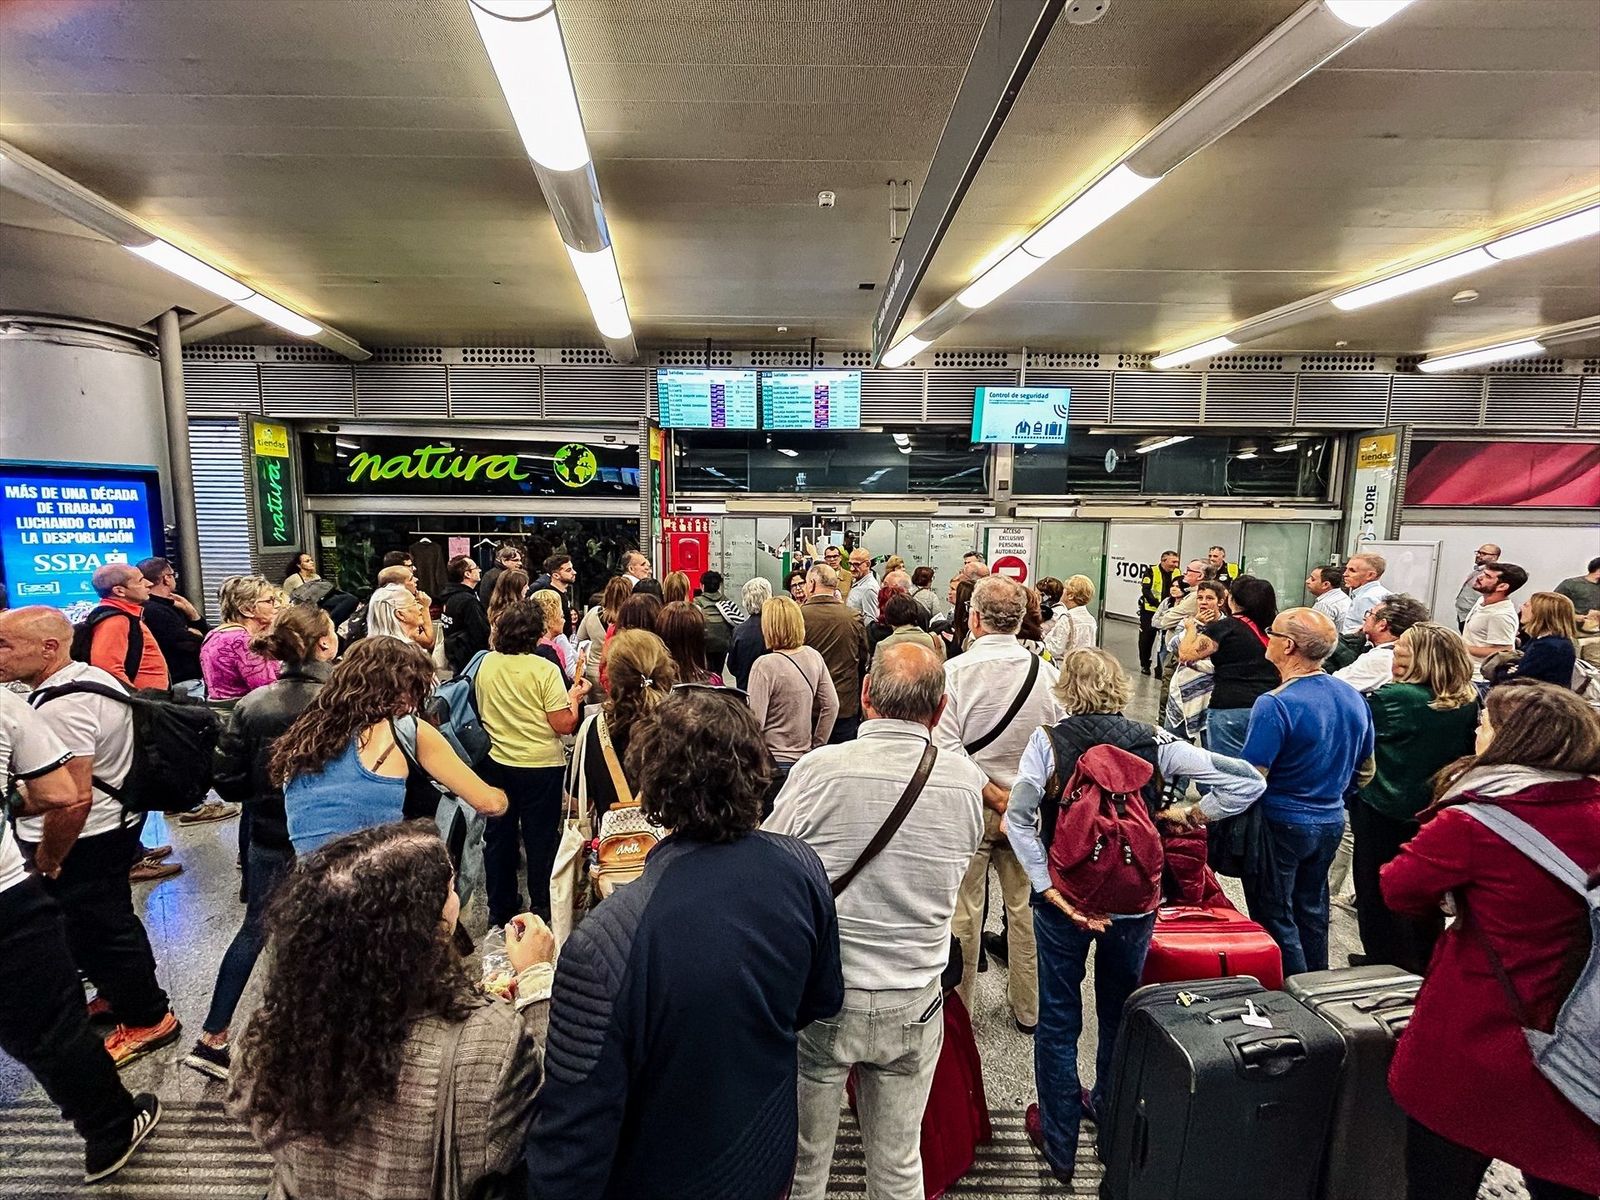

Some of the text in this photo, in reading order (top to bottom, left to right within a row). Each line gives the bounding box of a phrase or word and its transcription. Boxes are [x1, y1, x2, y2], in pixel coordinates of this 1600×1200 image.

[257, 439, 286, 449] tiendas
[347, 445, 530, 482] natura
[5, 483, 139, 501] MÁS DE UNA DÉCADA
[266, 459, 288, 542] natura
[36, 501, 114, 515] DE TRABAJO
[1363, 485, 1377, 525] STORE
[16, 516, 136, 529] LUCHANDO CONTRA
[21, 530, 134, 545] LA DESPOBLACIÓN
[34, 554, 102, 572] SSPA
